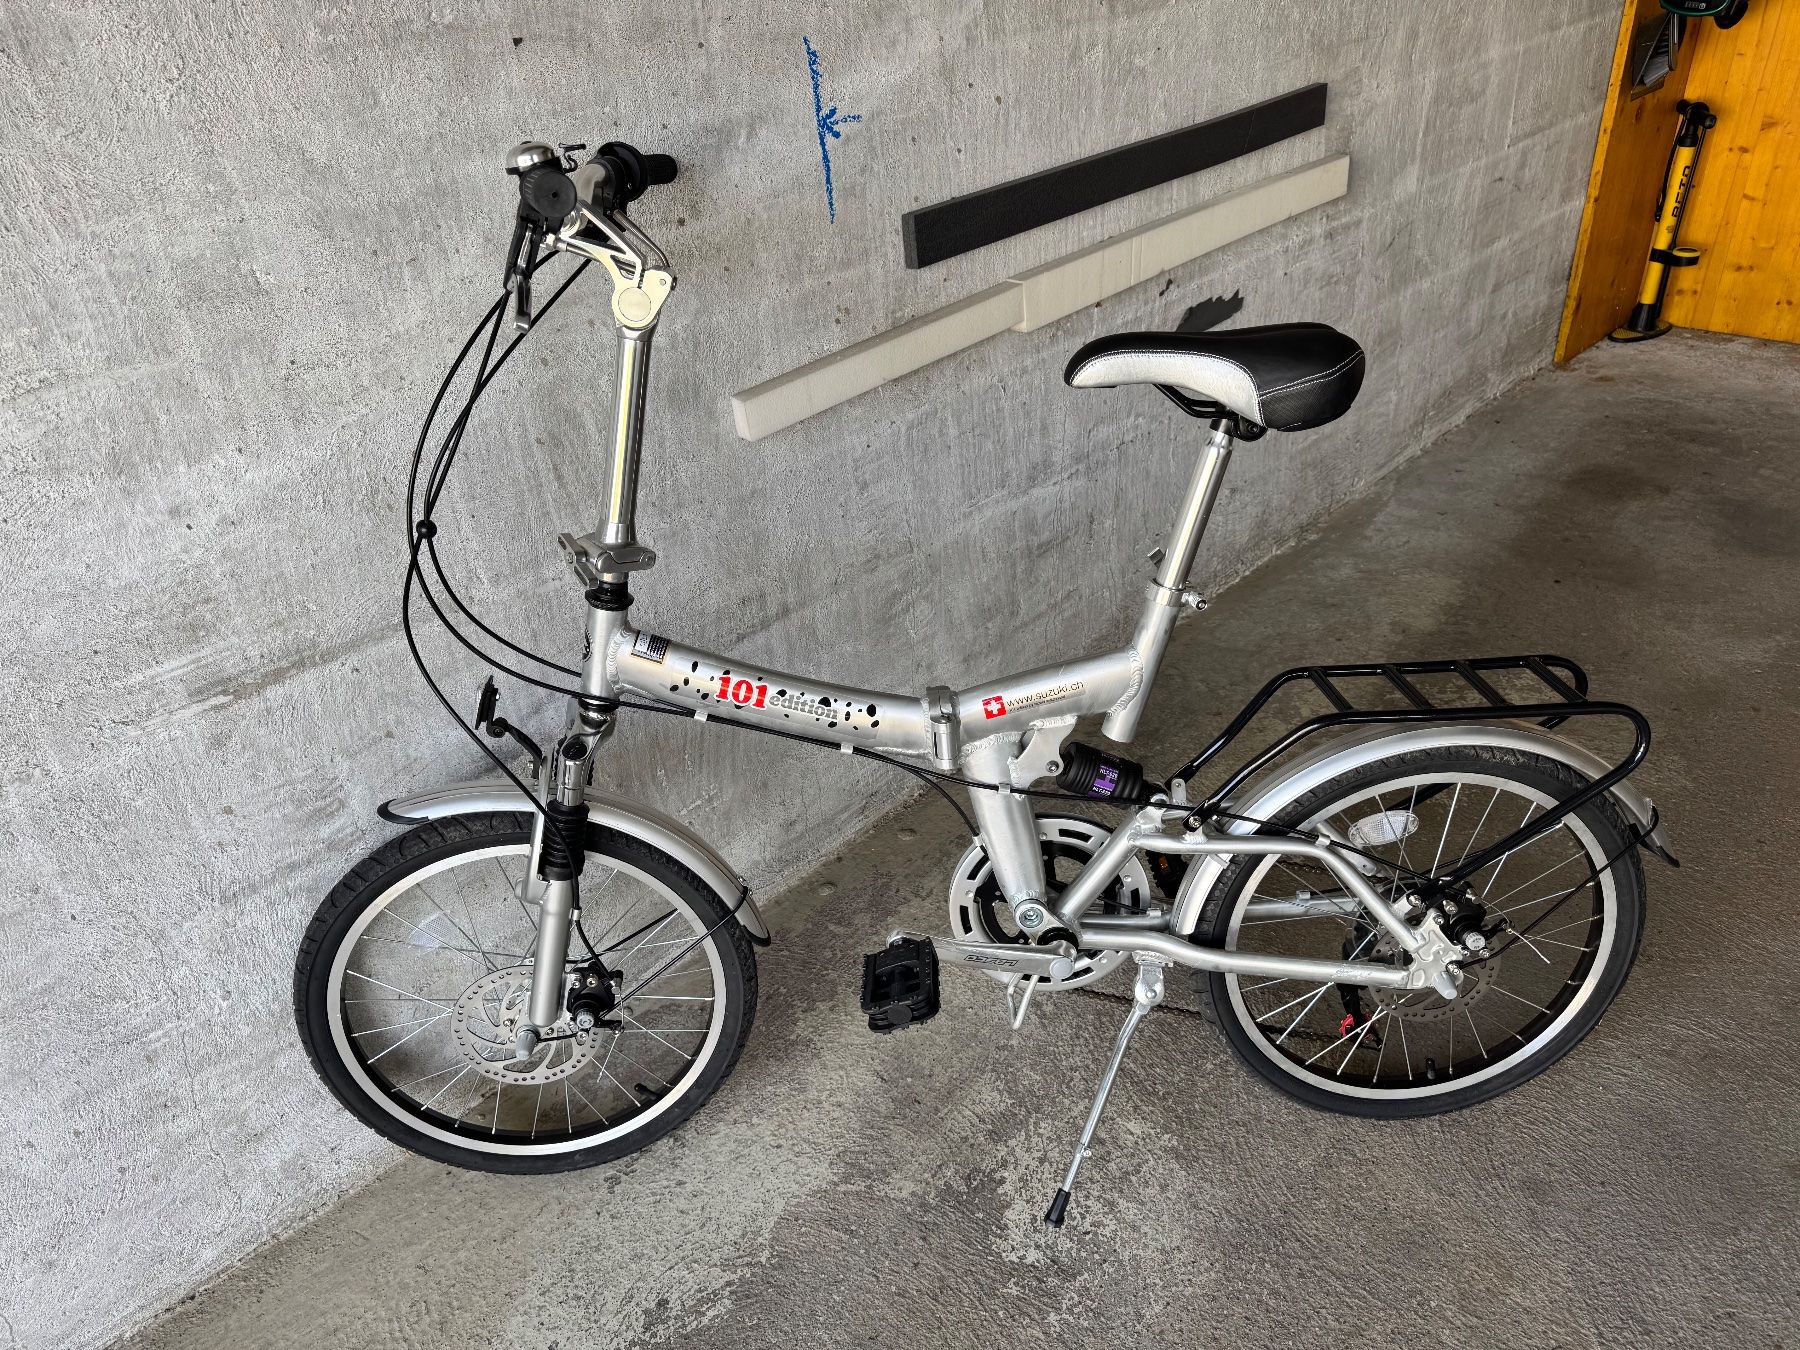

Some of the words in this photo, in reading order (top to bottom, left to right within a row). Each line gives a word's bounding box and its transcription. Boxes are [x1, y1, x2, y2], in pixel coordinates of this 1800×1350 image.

[715, 675, 769, 709] 101
[769, 693, 838, 720] edition
[1006, 681, 1084, 707] www.suzuki.ch
